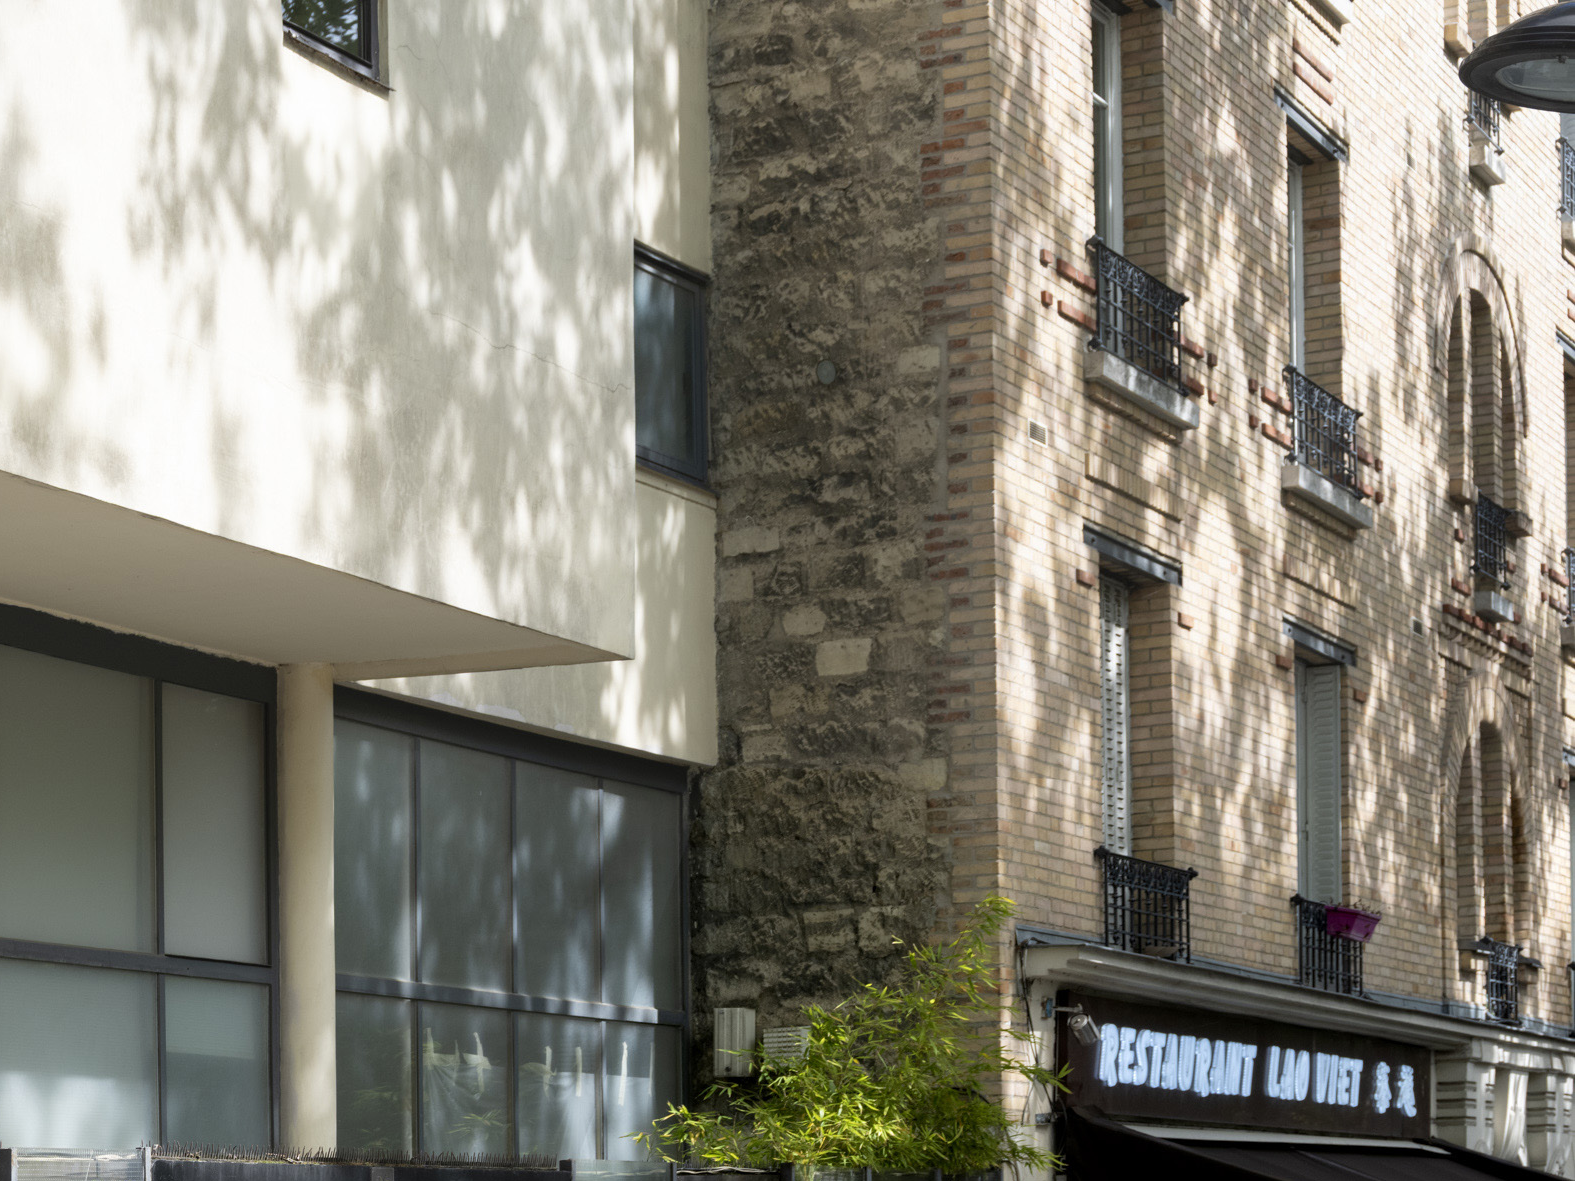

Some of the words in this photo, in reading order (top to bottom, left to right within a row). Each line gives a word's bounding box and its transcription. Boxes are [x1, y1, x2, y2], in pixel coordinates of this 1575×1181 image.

[1096, 1023, 1258, 1097] RESTAURANT
[1265, 1045, 1311, 1101] LAO
[1313, 1052, 1364, 1108] VIET
